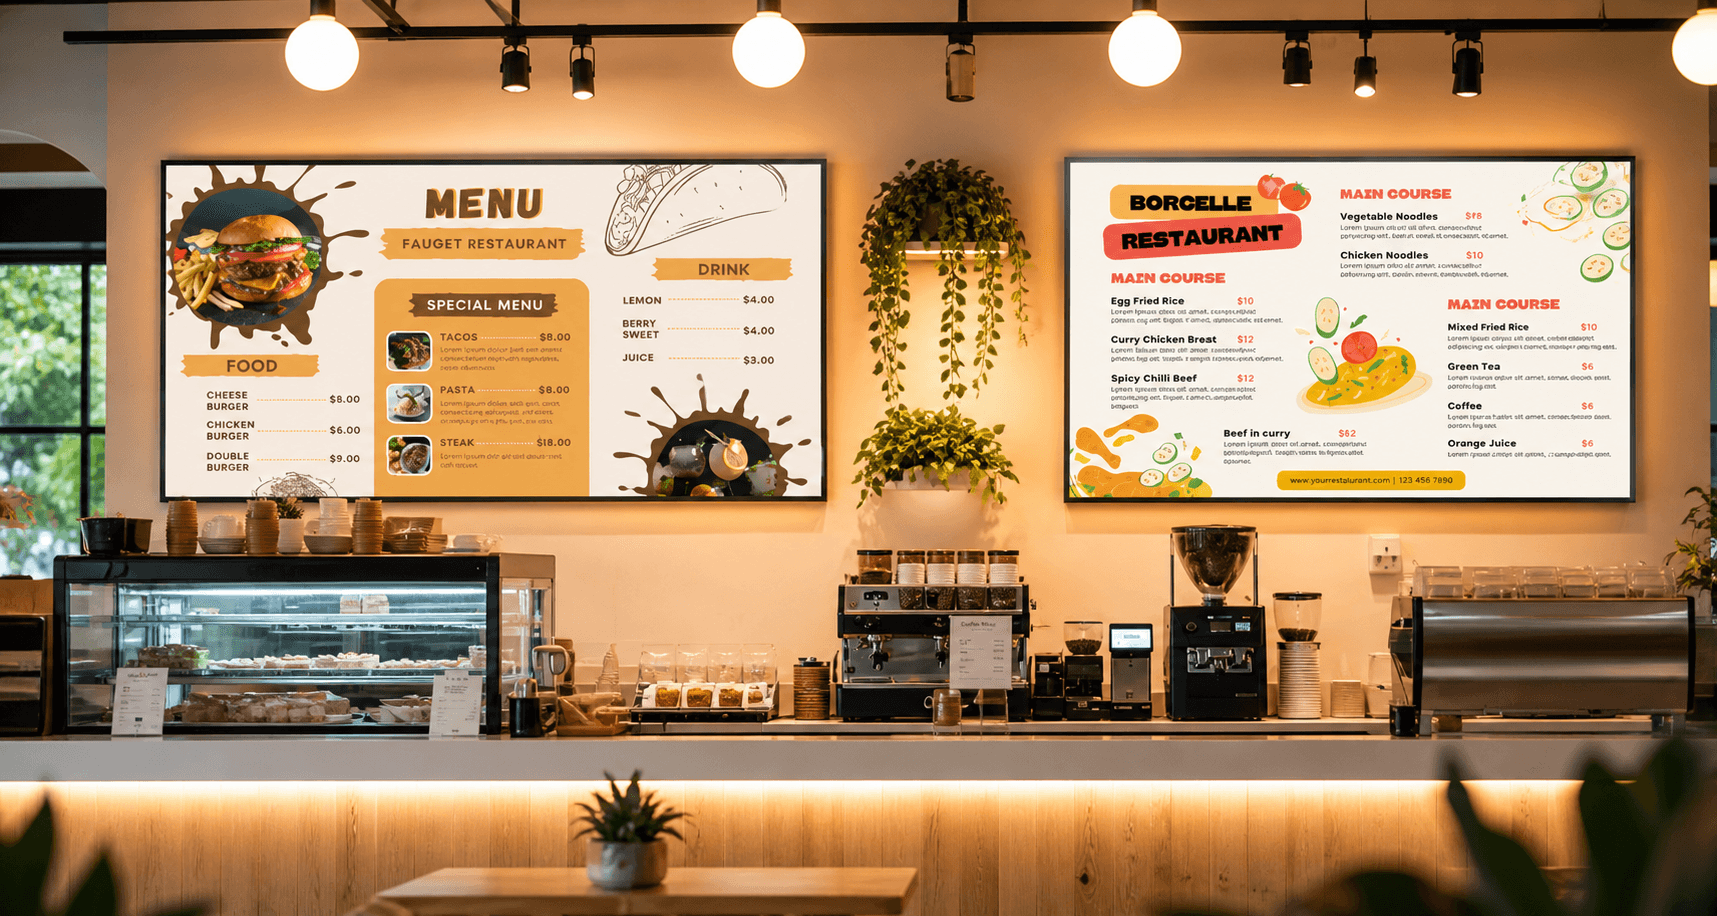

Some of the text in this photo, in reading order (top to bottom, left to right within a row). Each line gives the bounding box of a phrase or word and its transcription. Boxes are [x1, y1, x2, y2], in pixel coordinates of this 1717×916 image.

[1340, 189, 1451, 199] MAIN COURSE
[426, 188, 543, 219] MENU
[1130, 195, 1252, 211] BORCELLE
[1340, 213, 1393, 222] Vegetable
[1396, 212, 1438, 220] Noodles
[1122, 225, 1284, 249] RESTAURANT
[403, 239, 566, 249] FAUGET RESTAURANT
[1341, 251, 1483, 259] Chicken Noodles $10
[699, 264, 749, 275] DRINK
[1111, 273, 1225, 283] MAIN COURSE
[743, 295, 774, 304] $4.00
[1111, 297, 1254, 307] Egg Fried Rice $10
[1448, 299, 1560, 310] MAIN COURSE
[428, 300, 542, 310] SPECIAL MENU
[744, 326, 774, 335] $4.00
[1448, 323, 1597, 331] Mixed Fried Rice $10
[440, 333, 570, 342] TACOS $8.00
[623, 331, 659, 339] SWEET
[1111, 336, 1140, 345] Curry
[1143, 335, 1184, 343] Chicken
[1237, 335, 1254, 343] $12
[744, 356, 774, 365] $3.00
[227, 360, 277, 372] FOOD
[1582, 362, 1593, 370] $6
[1111, 374, 1254, 384] Spicy Chilli Beef $12
[441, 386, 569, 394] PASTA $8.00
[207, 391, 360, 404] CHEESE $8.00
[1448, 402, 1593, 410] Coffee $6
[330, 426, 360, 434] $6.00
[1224, 429, 1247, 437] Beef
[1250, 429, 1259, 437] in
[1263, 431, 1290, 439] curry
[207, 432, 249, 440] BURGER
[1448, 439, 1593, 449] Orange Juice $6
[207, 452, 360, 463] DOUBLE $9.00
